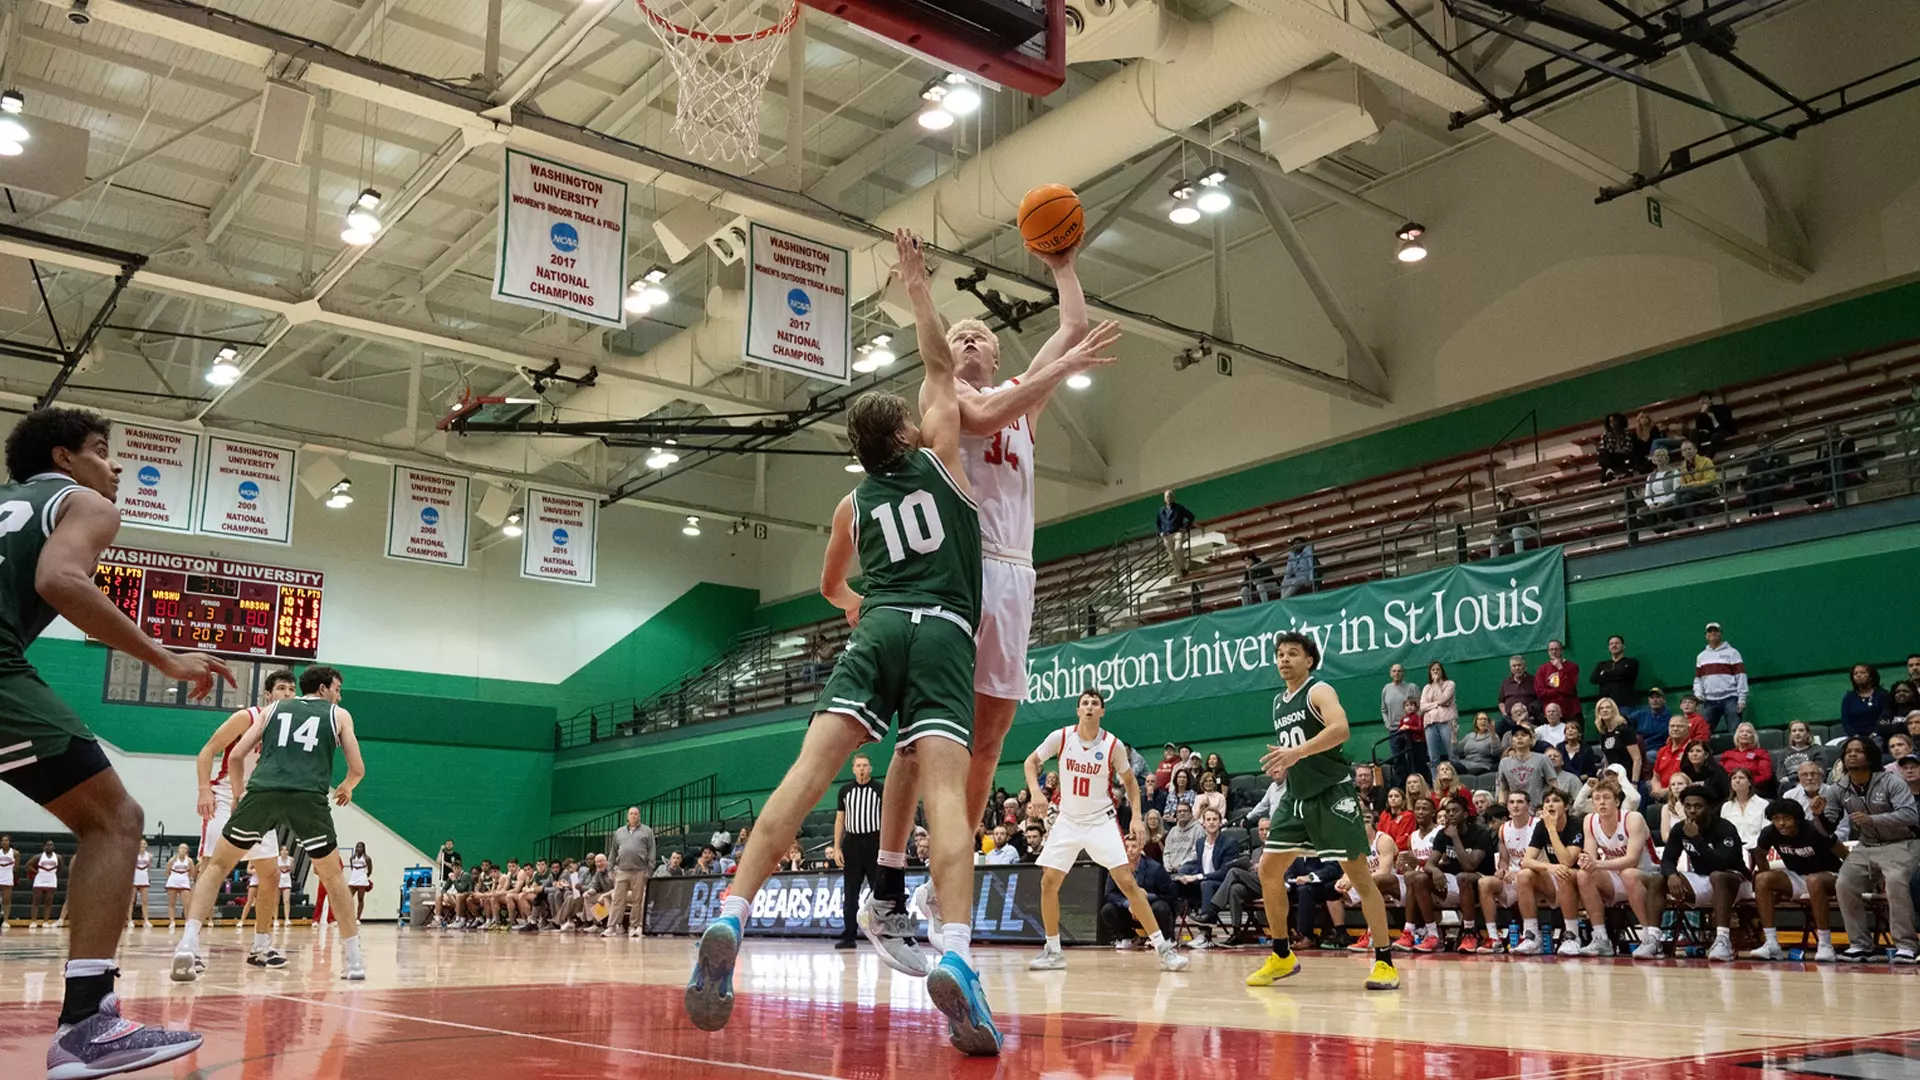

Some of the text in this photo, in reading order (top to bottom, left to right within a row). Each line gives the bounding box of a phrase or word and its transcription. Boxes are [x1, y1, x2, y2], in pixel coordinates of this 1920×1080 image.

[530, 164, 603, 194] WASHINGTON
[534, 182, 599, 208] UNIVERSITY
[512, 194, 620, 232] WOMEN'S INDOOR TRACK & FIELD
[1650, 200, 1660, 226] E
[552, 235, 578, 247] NCAA
[770, 236, 830, 262] WASHINGTON
[550, 254, 576, 268] 2017
[773, 252, 827, 276] UNIVERSITY
[536, 266, 589, 289] NATIONAL
[755, 263, 779, 278] WOMEN'S
[781, 271, 806, 286] OUTDOOR
[808, 279, 824, 292] TRACK
[830, 286, 845, 296] FIELD
[530, 282, 594, 306] CHAMPIONS
[789, 318, 810, 332] 2017
[777, 330, 821, 350] NATIONAL
[772, 344, 824, 366] CHAMPIONS
[1219, 355, 1230, 374] D
[125, 428, 181, 444] WASHINGTON
[127, 440, 178, 454] UNIVERSITY
[226, 444, 279, 460] WASHINGTON
[984, 430, 1020, 472] 34
[118, 452, 183, 467] MEN'S BASKETBALL
[228, 456, 276, 470] UNIVERSITY
[220, 466, 280, 482] MEN'S BASKETBALL
[409, 472, 456, 487] WASHINGTON
[138, 487, 158, 497] 2008
[411, 484, 453, 496] UNIVERSITY
[125, 497, 167, 511] NATIONAL
[238, 501, 257, 511] 2009
[430, 498, 450, 507] TENNIS
[542, 496, 584, 508] WASHINGTON
[120, 509, 169, 522] CHAMPIONS
[226, 512, 266, 524] NATIONAL
[544, 507, 581, 517] UNIVERSITY
[222, 524, 268, 536] CHAMPIONS
[757, 525, 765, 538] B
[870, 489, 946, 564] 10
[410, 537, 445, 548] NATIONAL
[406, 546, 448, 559] CHAMPIONS
[100, 548, 322, 586] WASHINGTON UNIVERSITY
[543, 556, 575, 566] NATIONAL
[96, 564, 142, 578] PLY FL PTS
[540, 566, 577, 577] CHAMPIONS
[115, 576, 121, 586] 2
[129, 579, 139, 587] 11
[128, 588, 138, 598] 13
[152, 590, 180, 601] WASHU
[281, 586, 321, 599] PLY FL PTS
[123, 599, 137, 609] 22
[156, 600, 178, 617] 80
[240, 600, 270, 611] BABSON
[284, 596, 319, 609] 10 4 6
[130, 610, 136, 619] 9
[206, 607, 214, 620] 3
[283, 606, 294, 615] 14
[246, 610, 268, 627] 80
[279, 616, 293, 627] 20
[295, 618, 302, 627] 2
[153, 624, 161, 636] 5
[192, 628, 224, 642] 20 2
[253, 634, 265, 646] 10
[278, 636, 291, 647] 42
[294, 638, 300, 647] 2
[1164, 616, 1333, 682] Univery
[1339, 608, 1379, 655] in
[277, 712, 321, 752] 14
[1066, 758, 1102, 774] WashU
[1073, 776, 1090, 797] 10
[752, 887, 814, 919] BEARS
